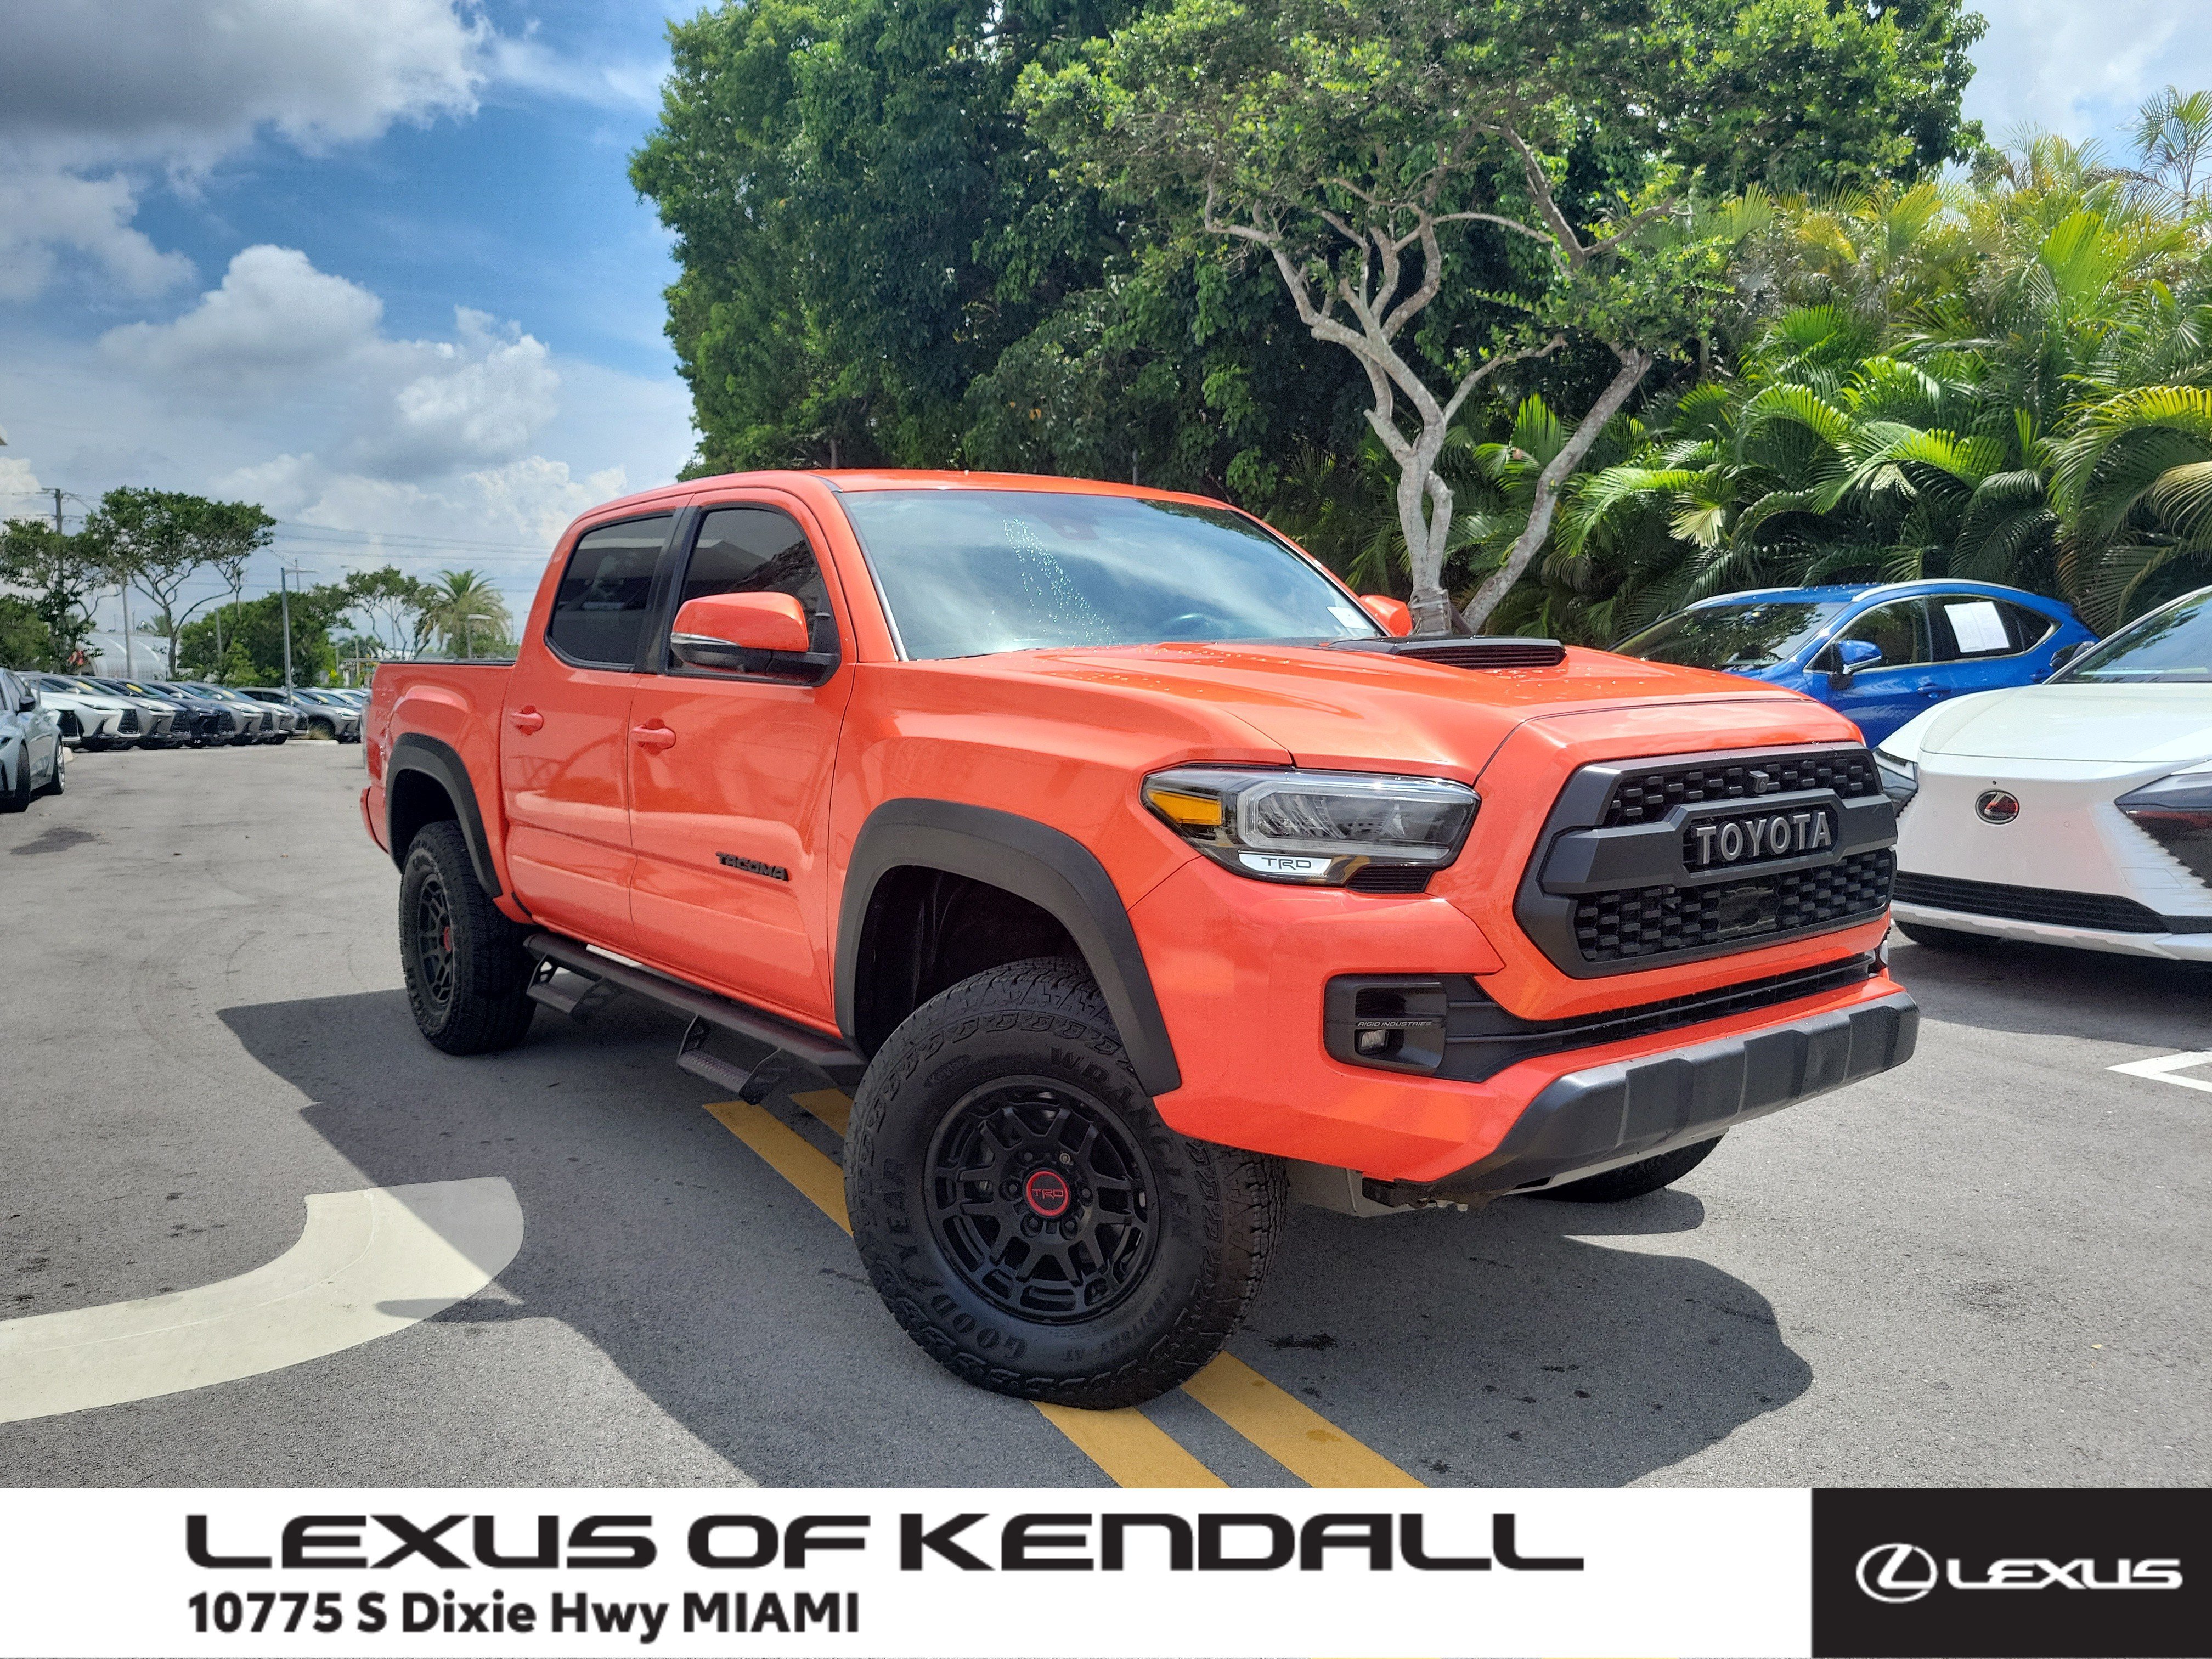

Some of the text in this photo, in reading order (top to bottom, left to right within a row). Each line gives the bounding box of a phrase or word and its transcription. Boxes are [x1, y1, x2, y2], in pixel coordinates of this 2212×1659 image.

[1695, 811, 1832, 865] TOYOTA
[715, 851, 790, 882] TACOMA
[1261, 857, 1312, 871] TRD
[1050, 1047, 1192, 1239] WRANGLER
[1031, 1188, 1064, 1199] TRD
[883, 1158, 1028, 1361] GOODYEAR
